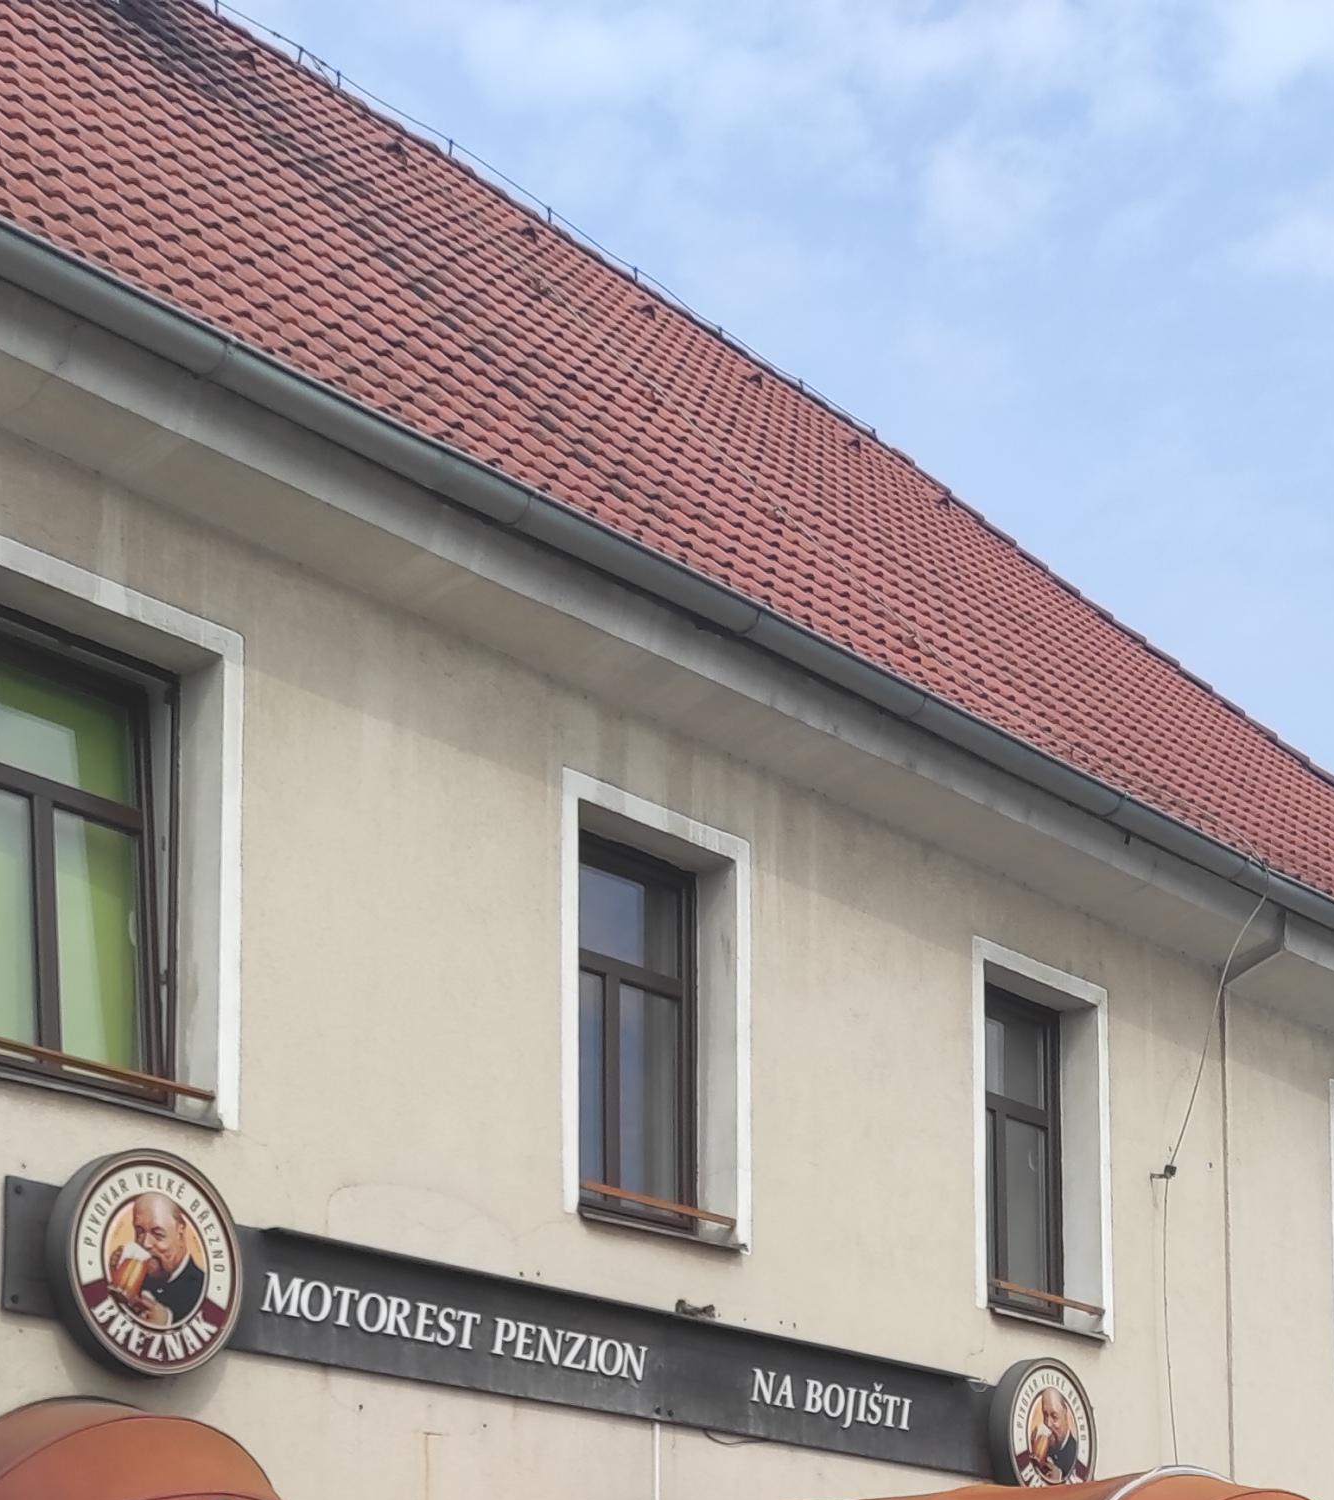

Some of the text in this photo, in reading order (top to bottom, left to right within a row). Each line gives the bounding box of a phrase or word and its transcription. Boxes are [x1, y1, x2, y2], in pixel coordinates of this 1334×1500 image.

[84, 1172, 225, 1273] PIVOVAR VELKÉ BŘEZNO
[261, 1271, 649, 1379] MOTOREST PENZION
[750, 1368, 913, 1432] NA BOJIŠTI
